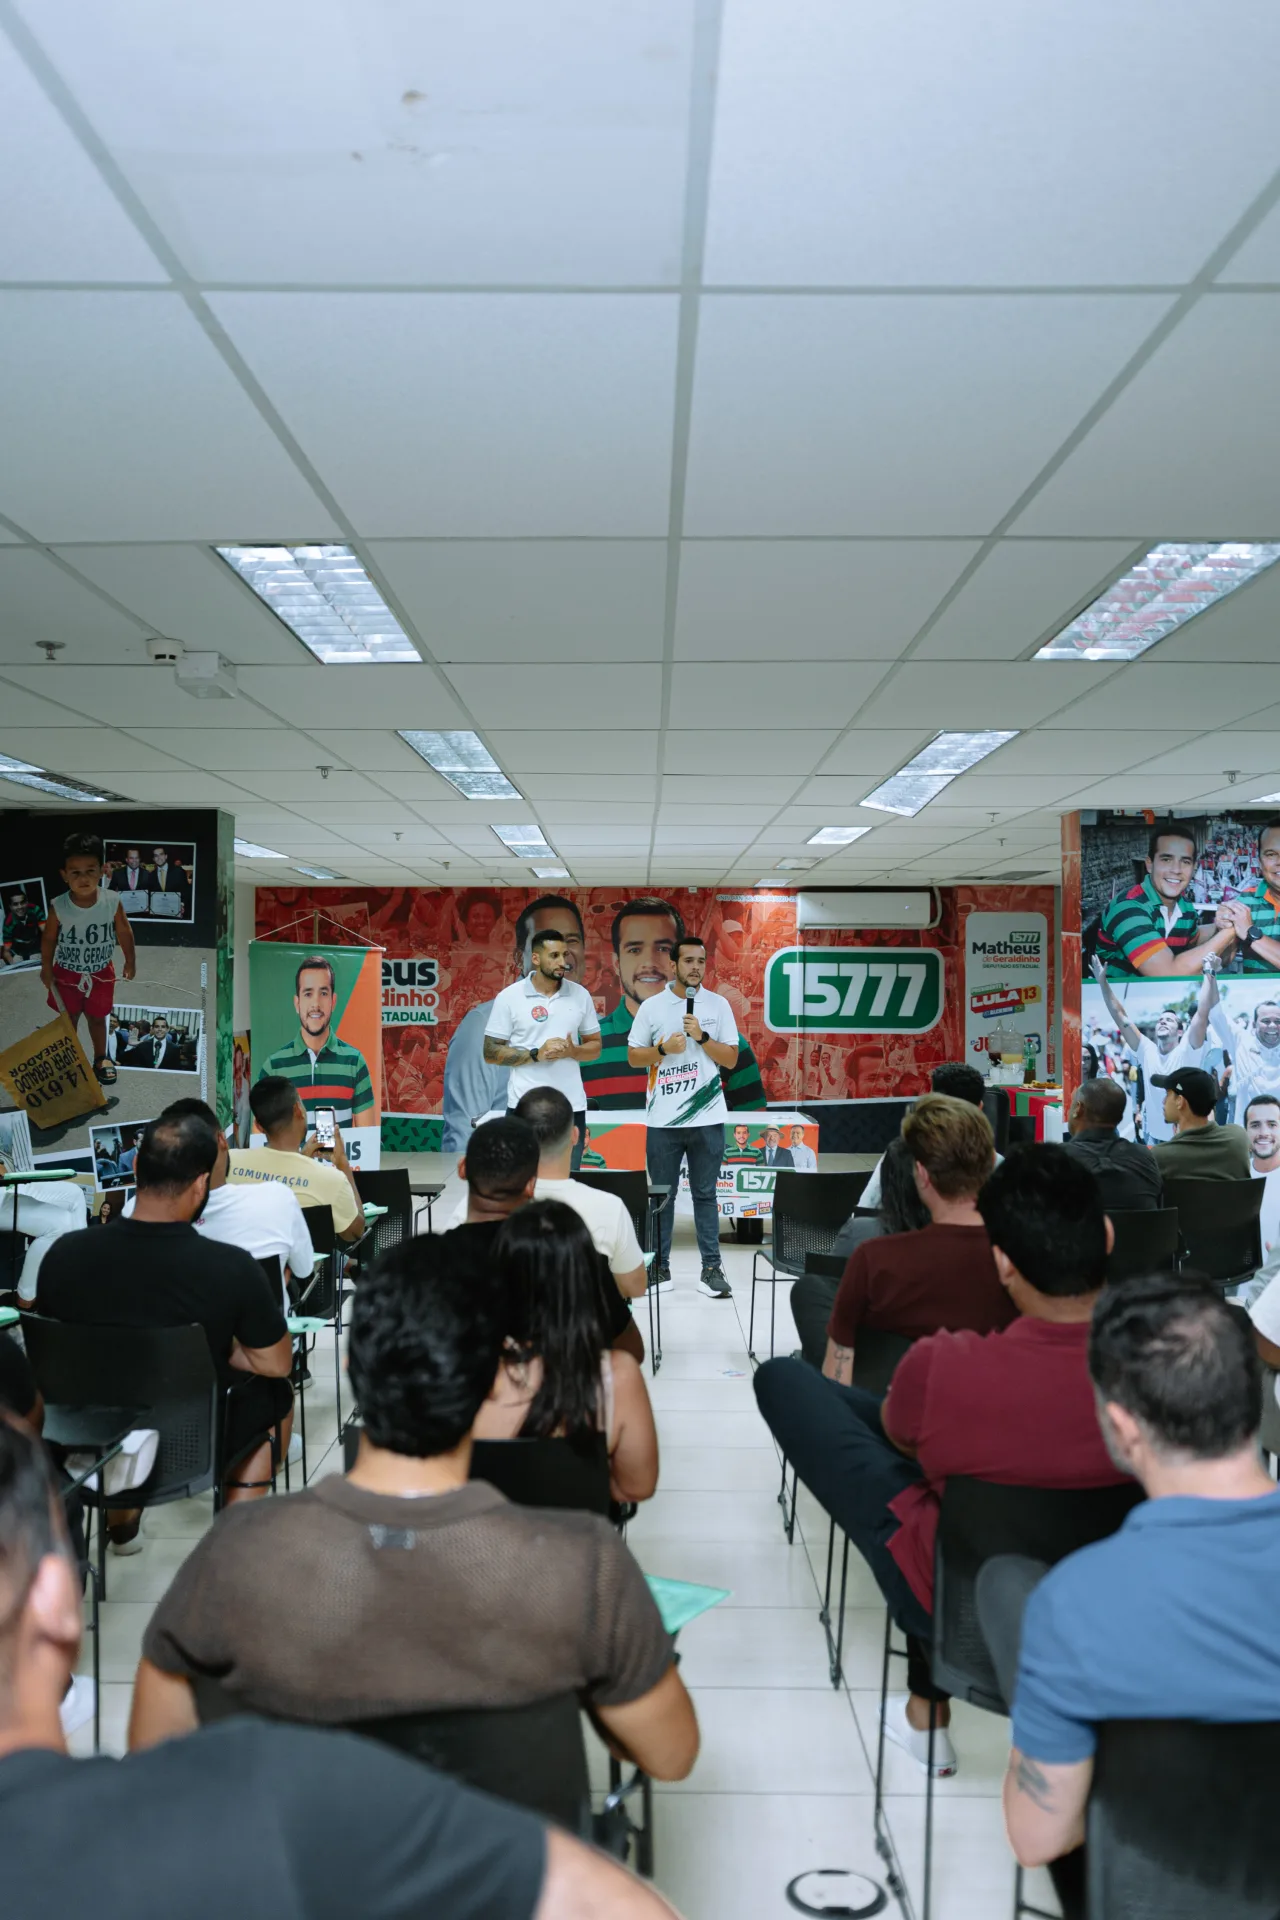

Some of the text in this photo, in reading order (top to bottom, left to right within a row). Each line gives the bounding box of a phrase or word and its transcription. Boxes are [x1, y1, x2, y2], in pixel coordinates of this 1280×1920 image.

[972, 941, 1040, 954] Matheus
[993, 955, 1040, 963] Geraldinho
[783, 963, 926, 1017] 15777
[972, 987, 1037, 1008] LULA 13
[9, 1036, 72, 1077] VEREADOR
[14, 1060, 54, 1094] GERALDO
[659, 1062, 698, 1077] MATHEUS
[26, 1063, 89, 1108] 14.610
[661, 1078, 697, 1096] 15777
[233, 1167, 309, 1188] COMUNICAÇÃO
[724, 1204, 733, 1213] 13
